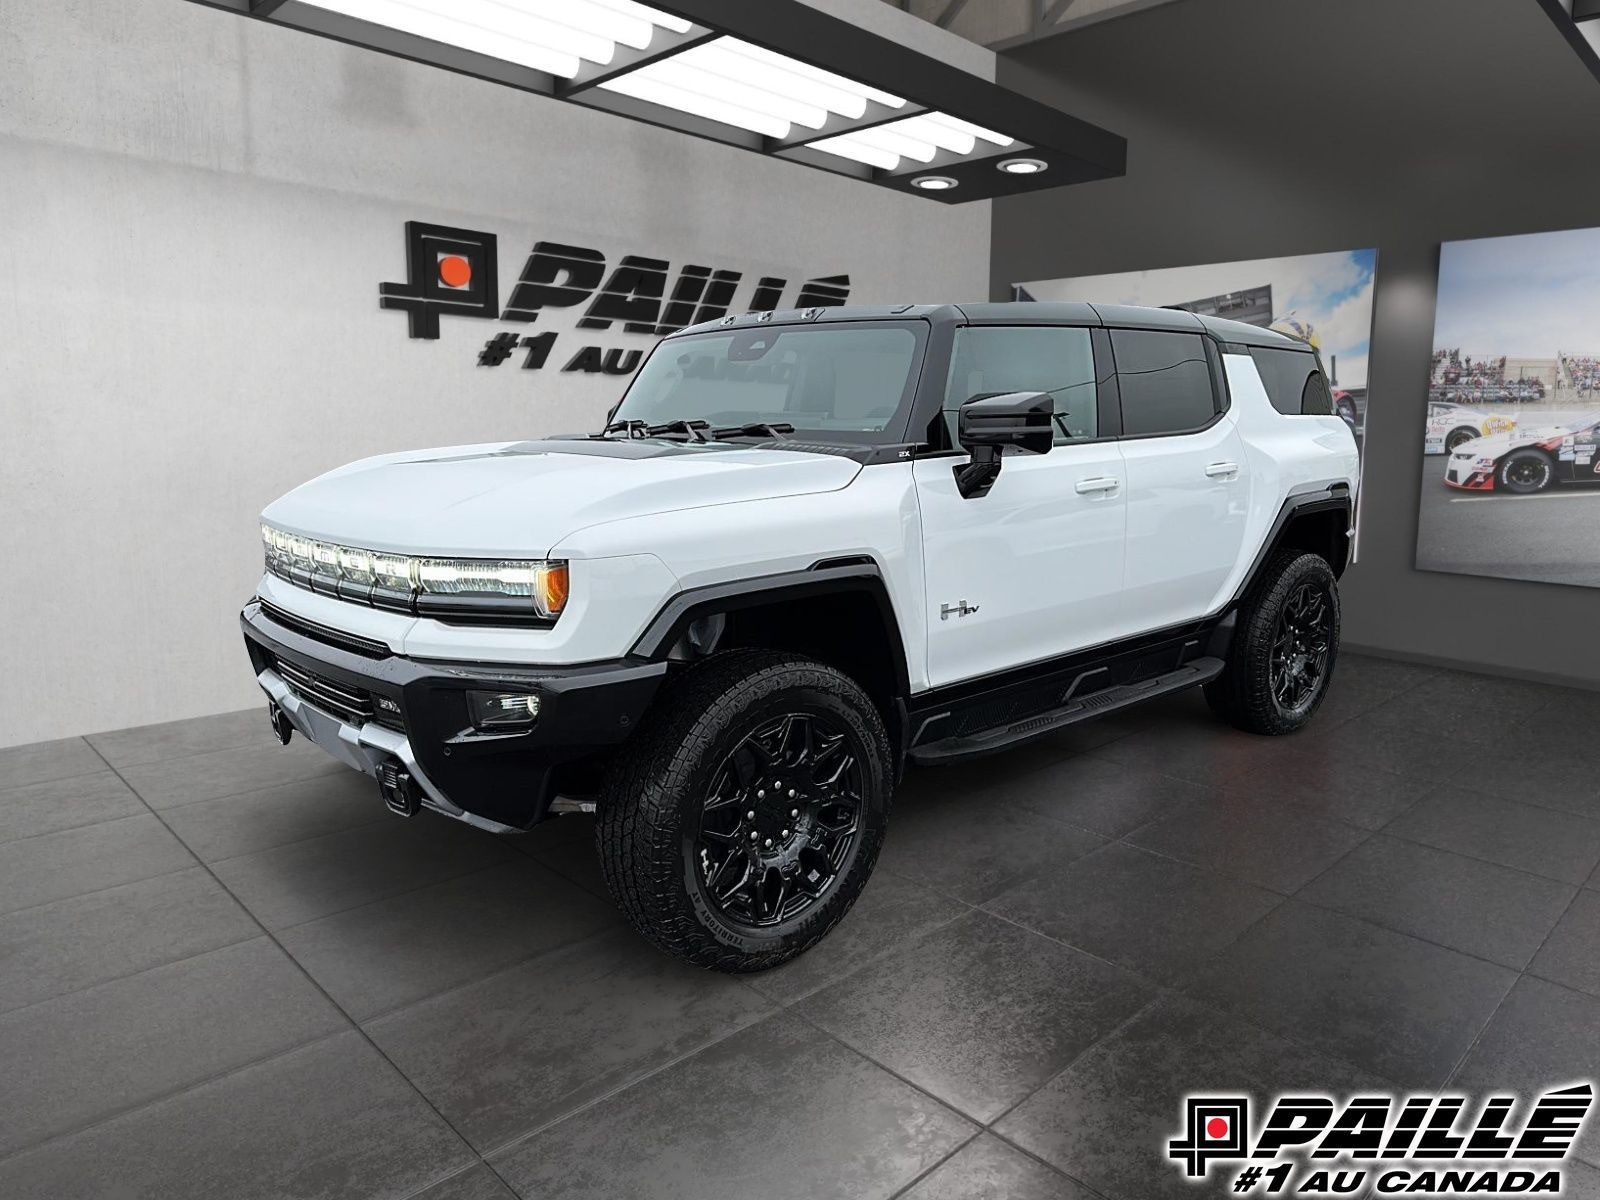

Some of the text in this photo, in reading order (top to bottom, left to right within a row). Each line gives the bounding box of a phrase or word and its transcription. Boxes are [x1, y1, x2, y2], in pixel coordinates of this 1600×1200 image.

[477, 332, 644, 375] #1 AU
[690, 891, 743, 945] TERRITORY AT
